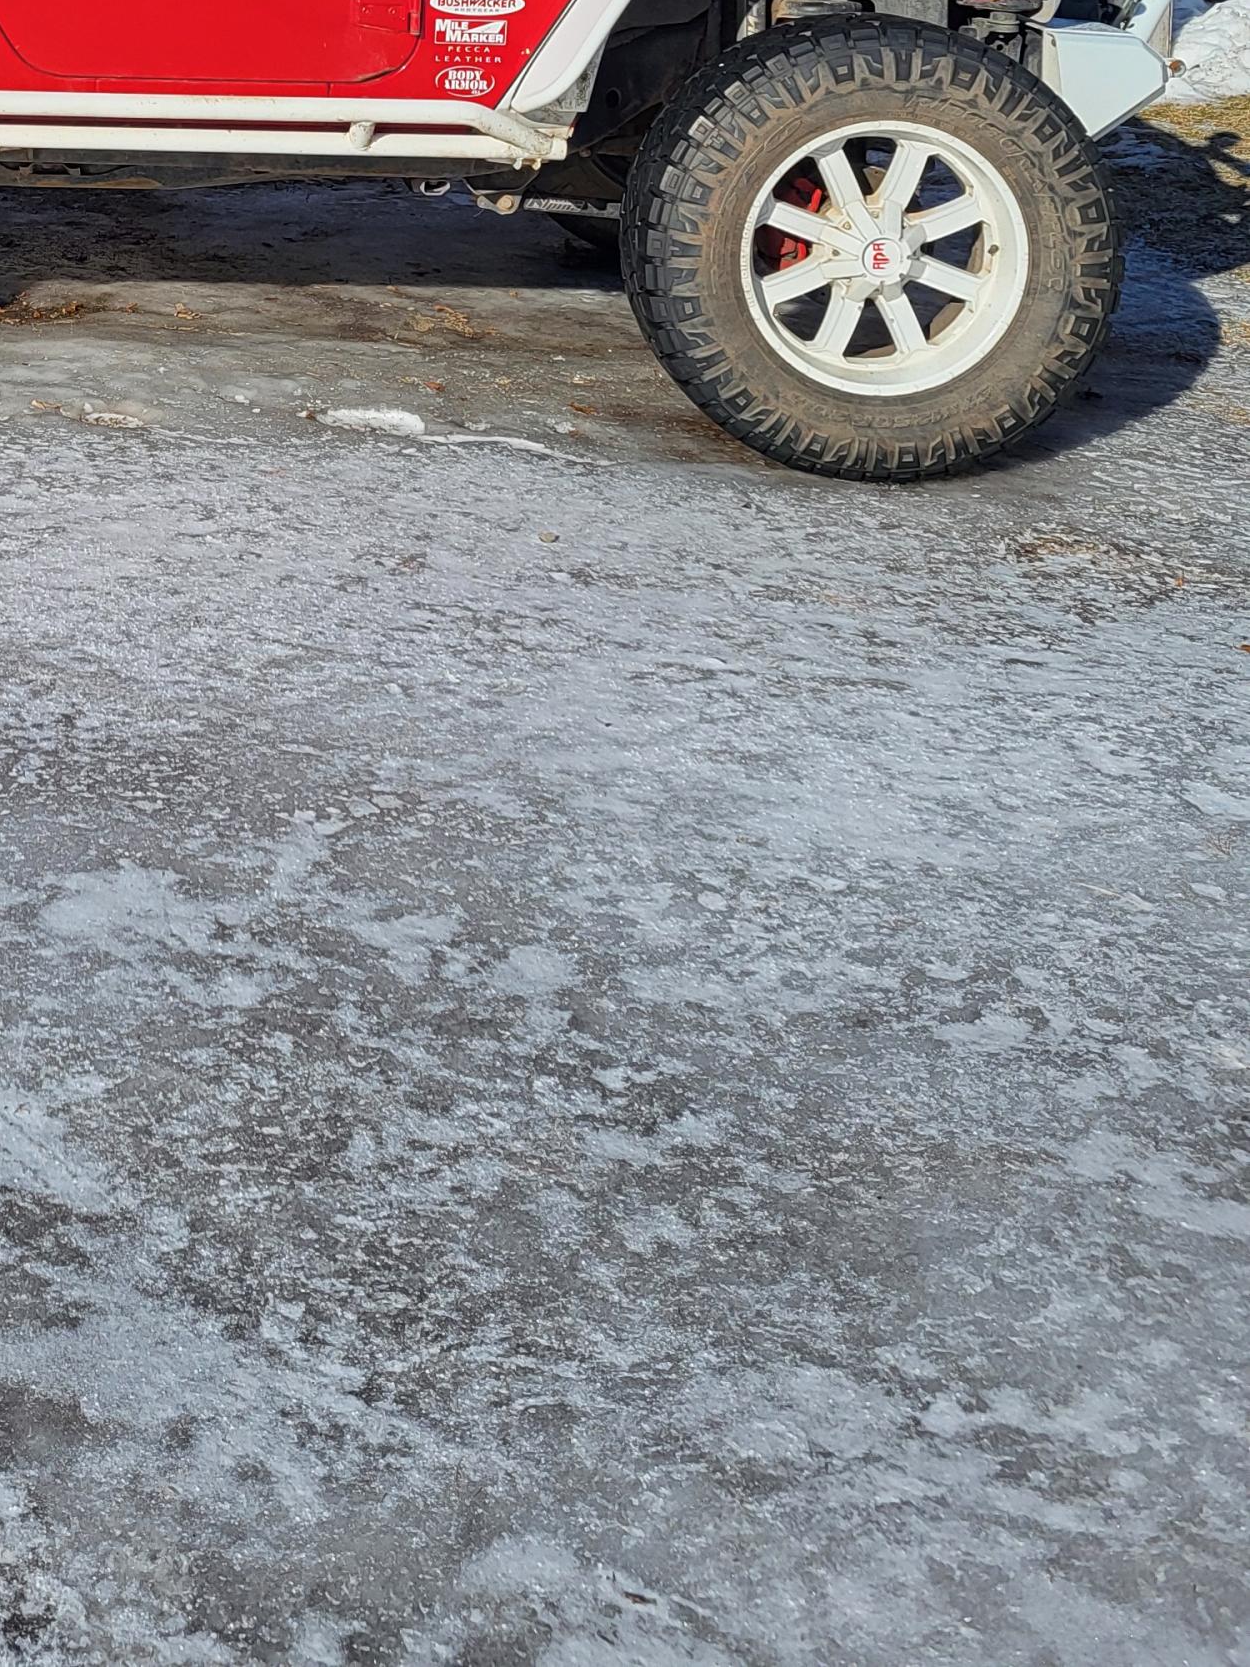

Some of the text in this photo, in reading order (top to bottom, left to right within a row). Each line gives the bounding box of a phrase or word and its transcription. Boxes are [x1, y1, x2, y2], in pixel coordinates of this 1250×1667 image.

[435, 18, 469, 32] MILE
[445, 30, 504, 43] MARKER
[447, 45, 490, 53] PECCA
[435, 55, 502, 64] LEATHER
[448, 69, 484, 81] BODY
[444, 79, 489, 91] ARMOR
